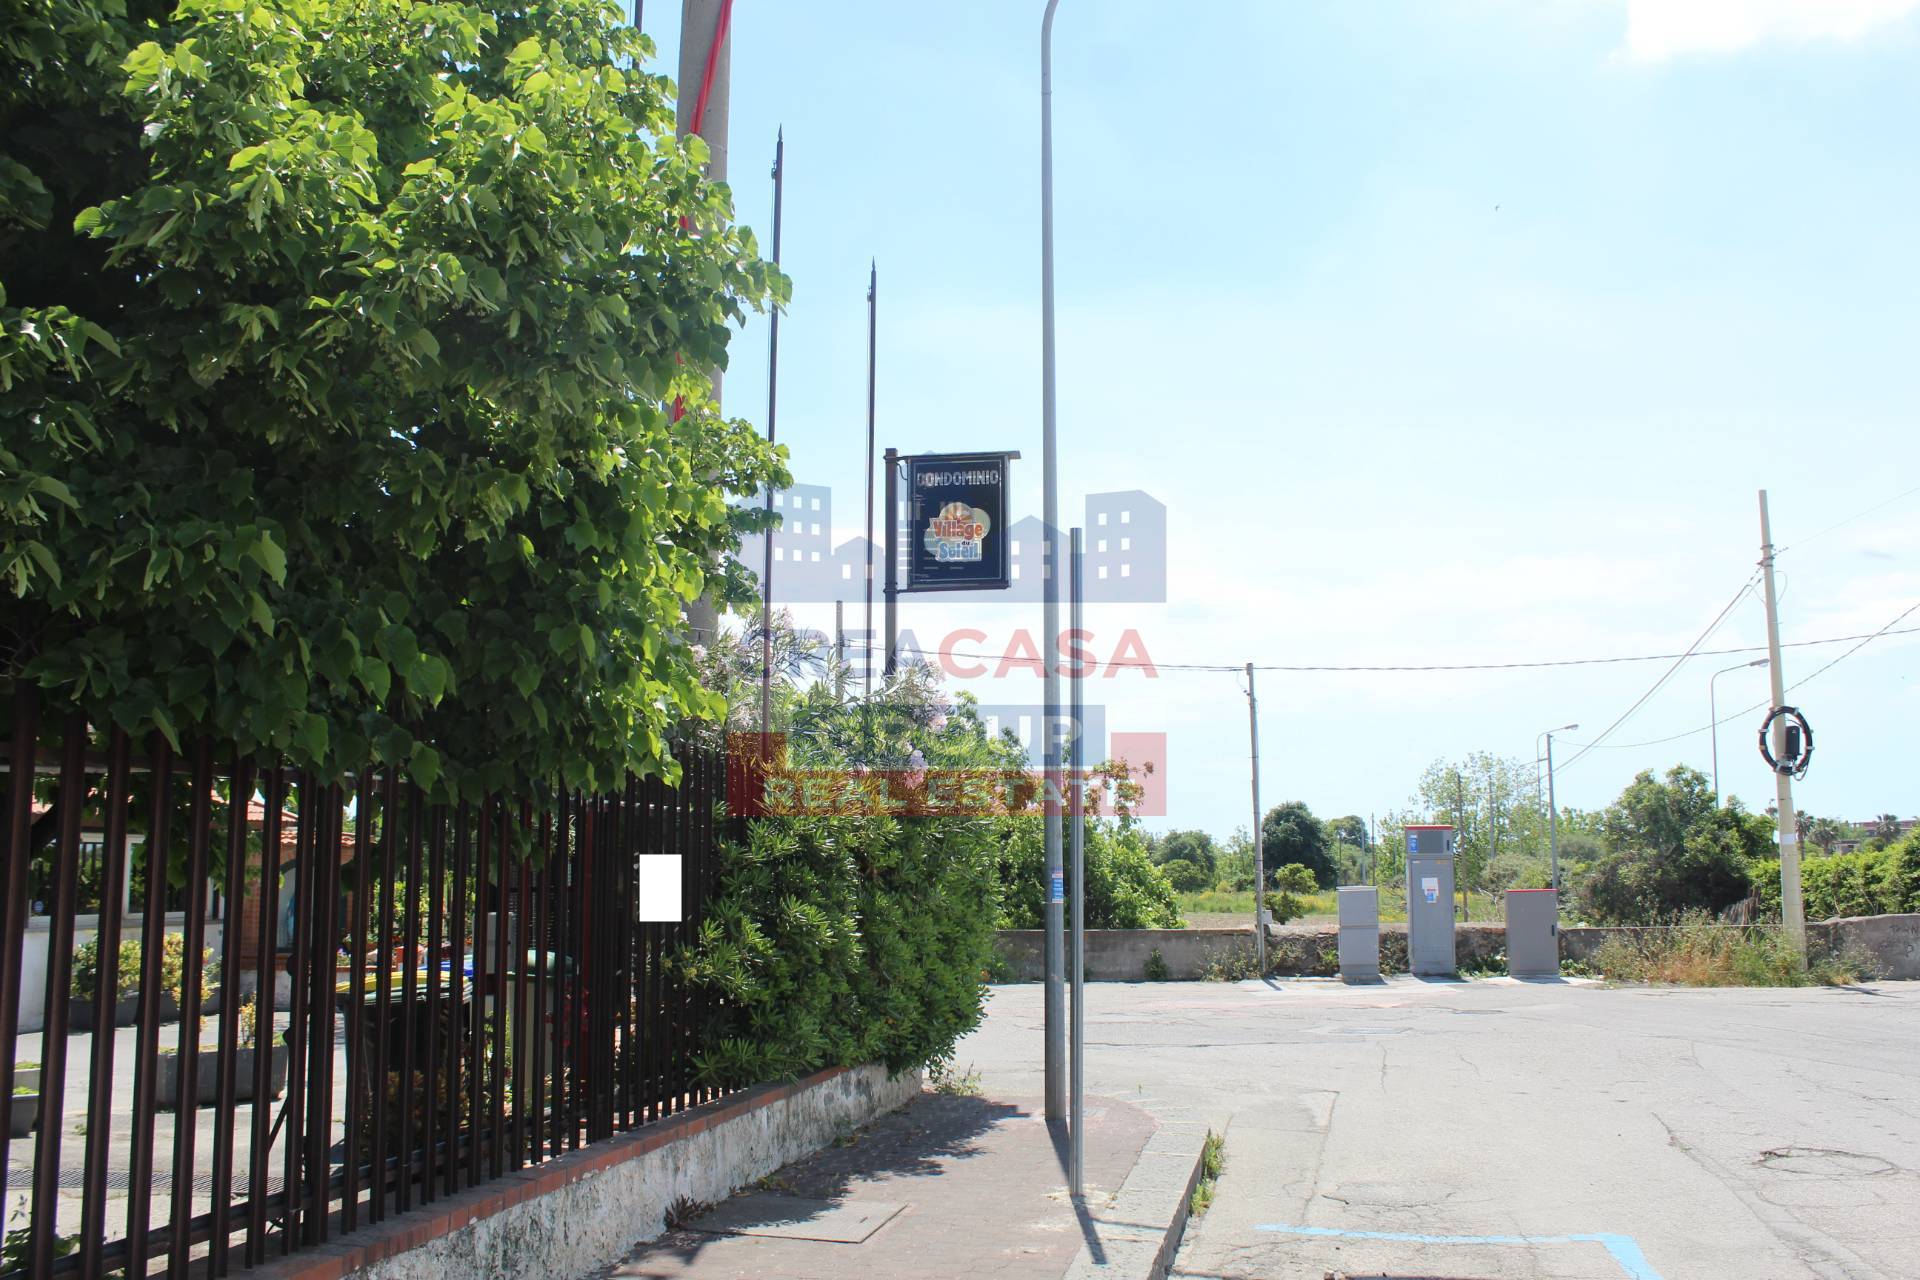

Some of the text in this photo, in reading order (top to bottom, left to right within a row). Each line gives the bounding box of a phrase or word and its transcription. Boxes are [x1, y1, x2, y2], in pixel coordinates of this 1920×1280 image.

[916, 469, 999, 487] CONDOMINIO
[933, 519, 984, 541] Village
[939, 541, 978, 560] Soleil
